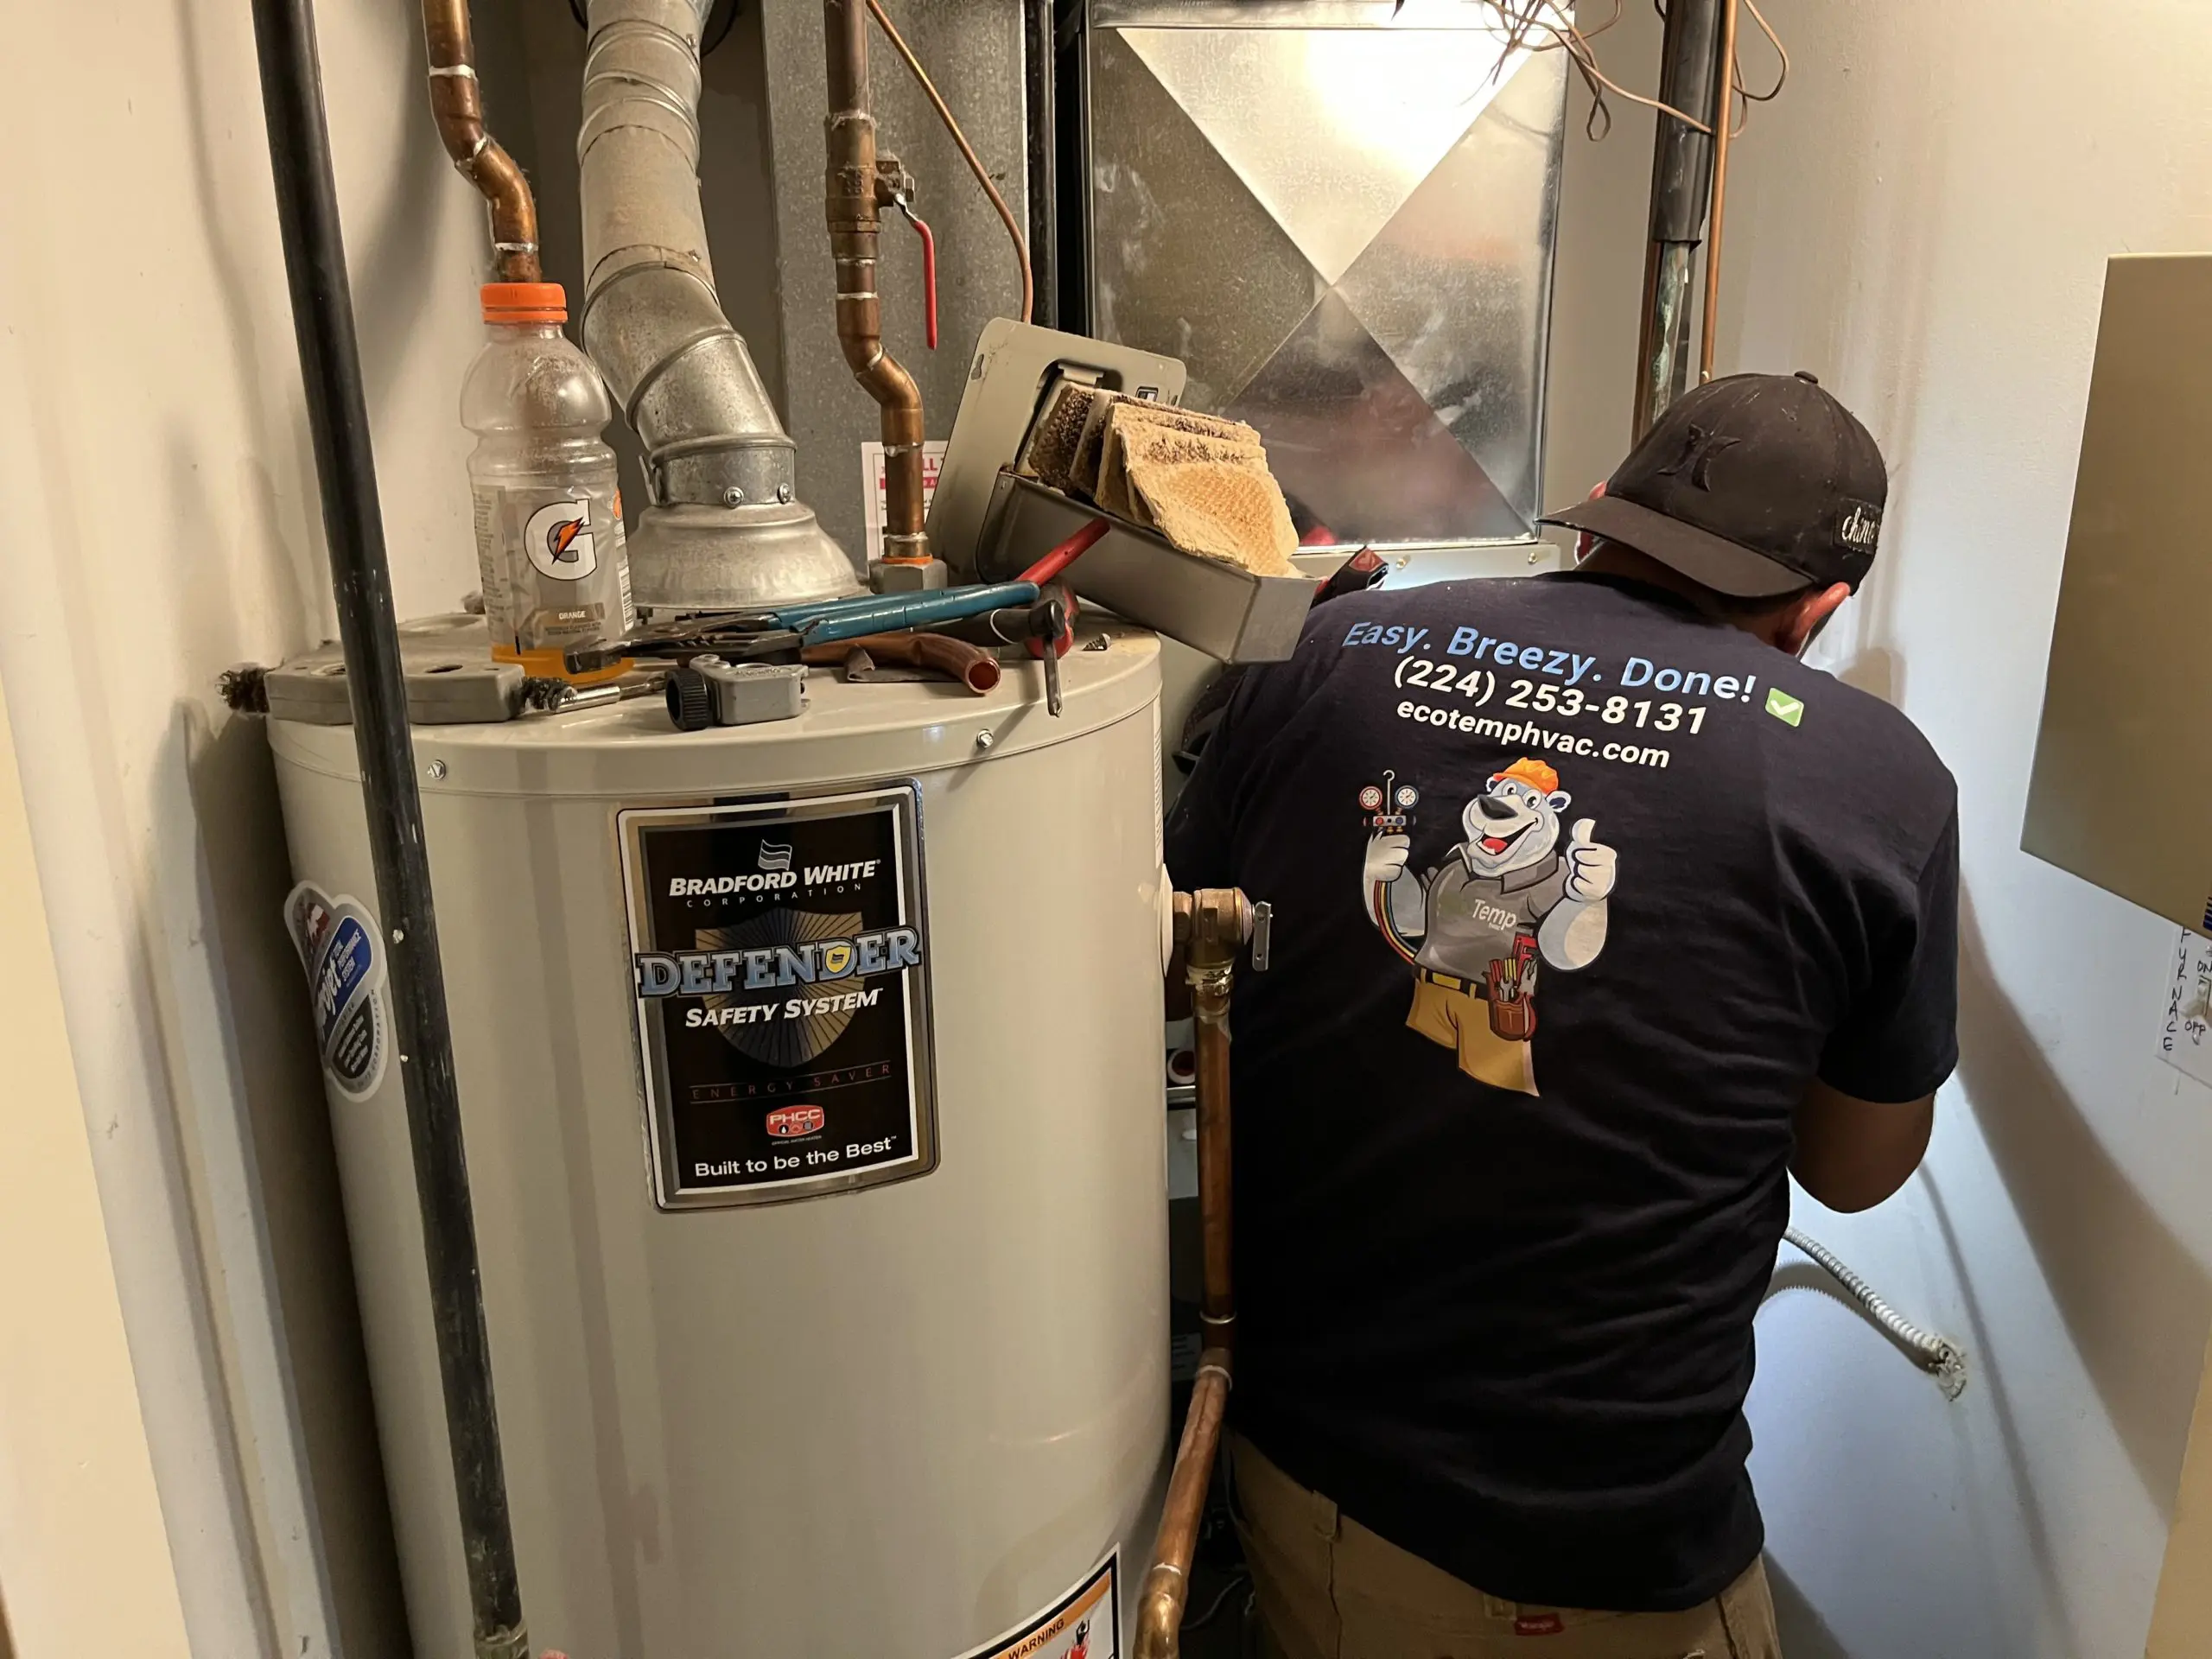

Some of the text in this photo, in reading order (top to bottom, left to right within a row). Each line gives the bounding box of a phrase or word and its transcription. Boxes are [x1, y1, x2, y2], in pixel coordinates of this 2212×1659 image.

[558, 610, 586, 620] ORANGE
[1342, 621, 1757, 703] Easy. Breezy. Done!
[1395, 655, 1707, 734] (224) 253-8131
[1397, 700, 1670, 768] ecotemphvac.com
[669, 871, 797, 897] BRADFORD
[687, 883, 861, 907] CORPORATION
[1472, 899, 1516, 931] Temp
[636, 926, 921, 997] DEFENDER
[685, 990, 879, 1027] SAFETY SYSTEM
[692, 1064, 890, 1100] ENERGY SAVER
[769, 1109, 821, 1125] PHCC
[695, 1162, 741, 1177] Built
[746, 1160, 767, 1173] to
[774, 1154, 800, 1170] be
[806, 1149, 840, 1165] the
[1007, 1618, 1065, 1659] WARNING
